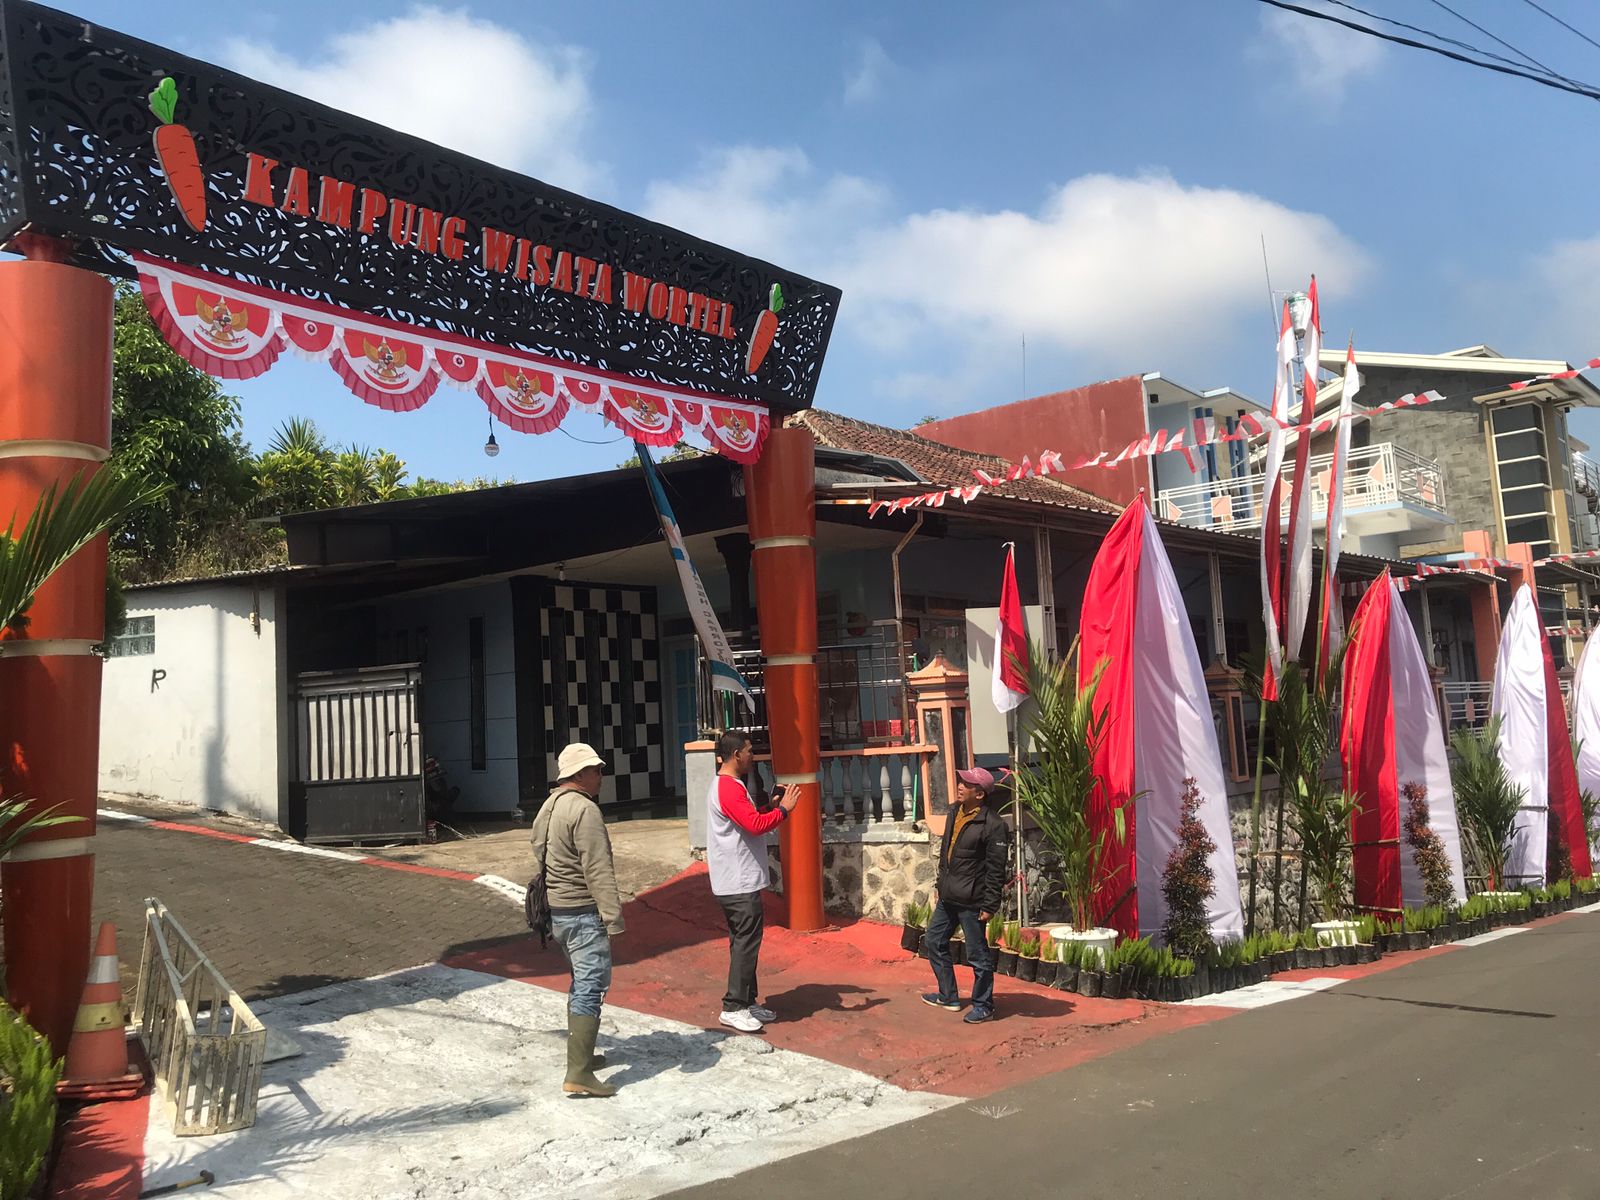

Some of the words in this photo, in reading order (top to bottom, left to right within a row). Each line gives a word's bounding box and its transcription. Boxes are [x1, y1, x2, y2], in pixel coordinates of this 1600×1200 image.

[242, 152, 467, 261] KAMPUNG
[481, 226, 612, 304] WISATA
[622, 271, 735, 340] WORTEL
[150, 668, 167, 694] R
